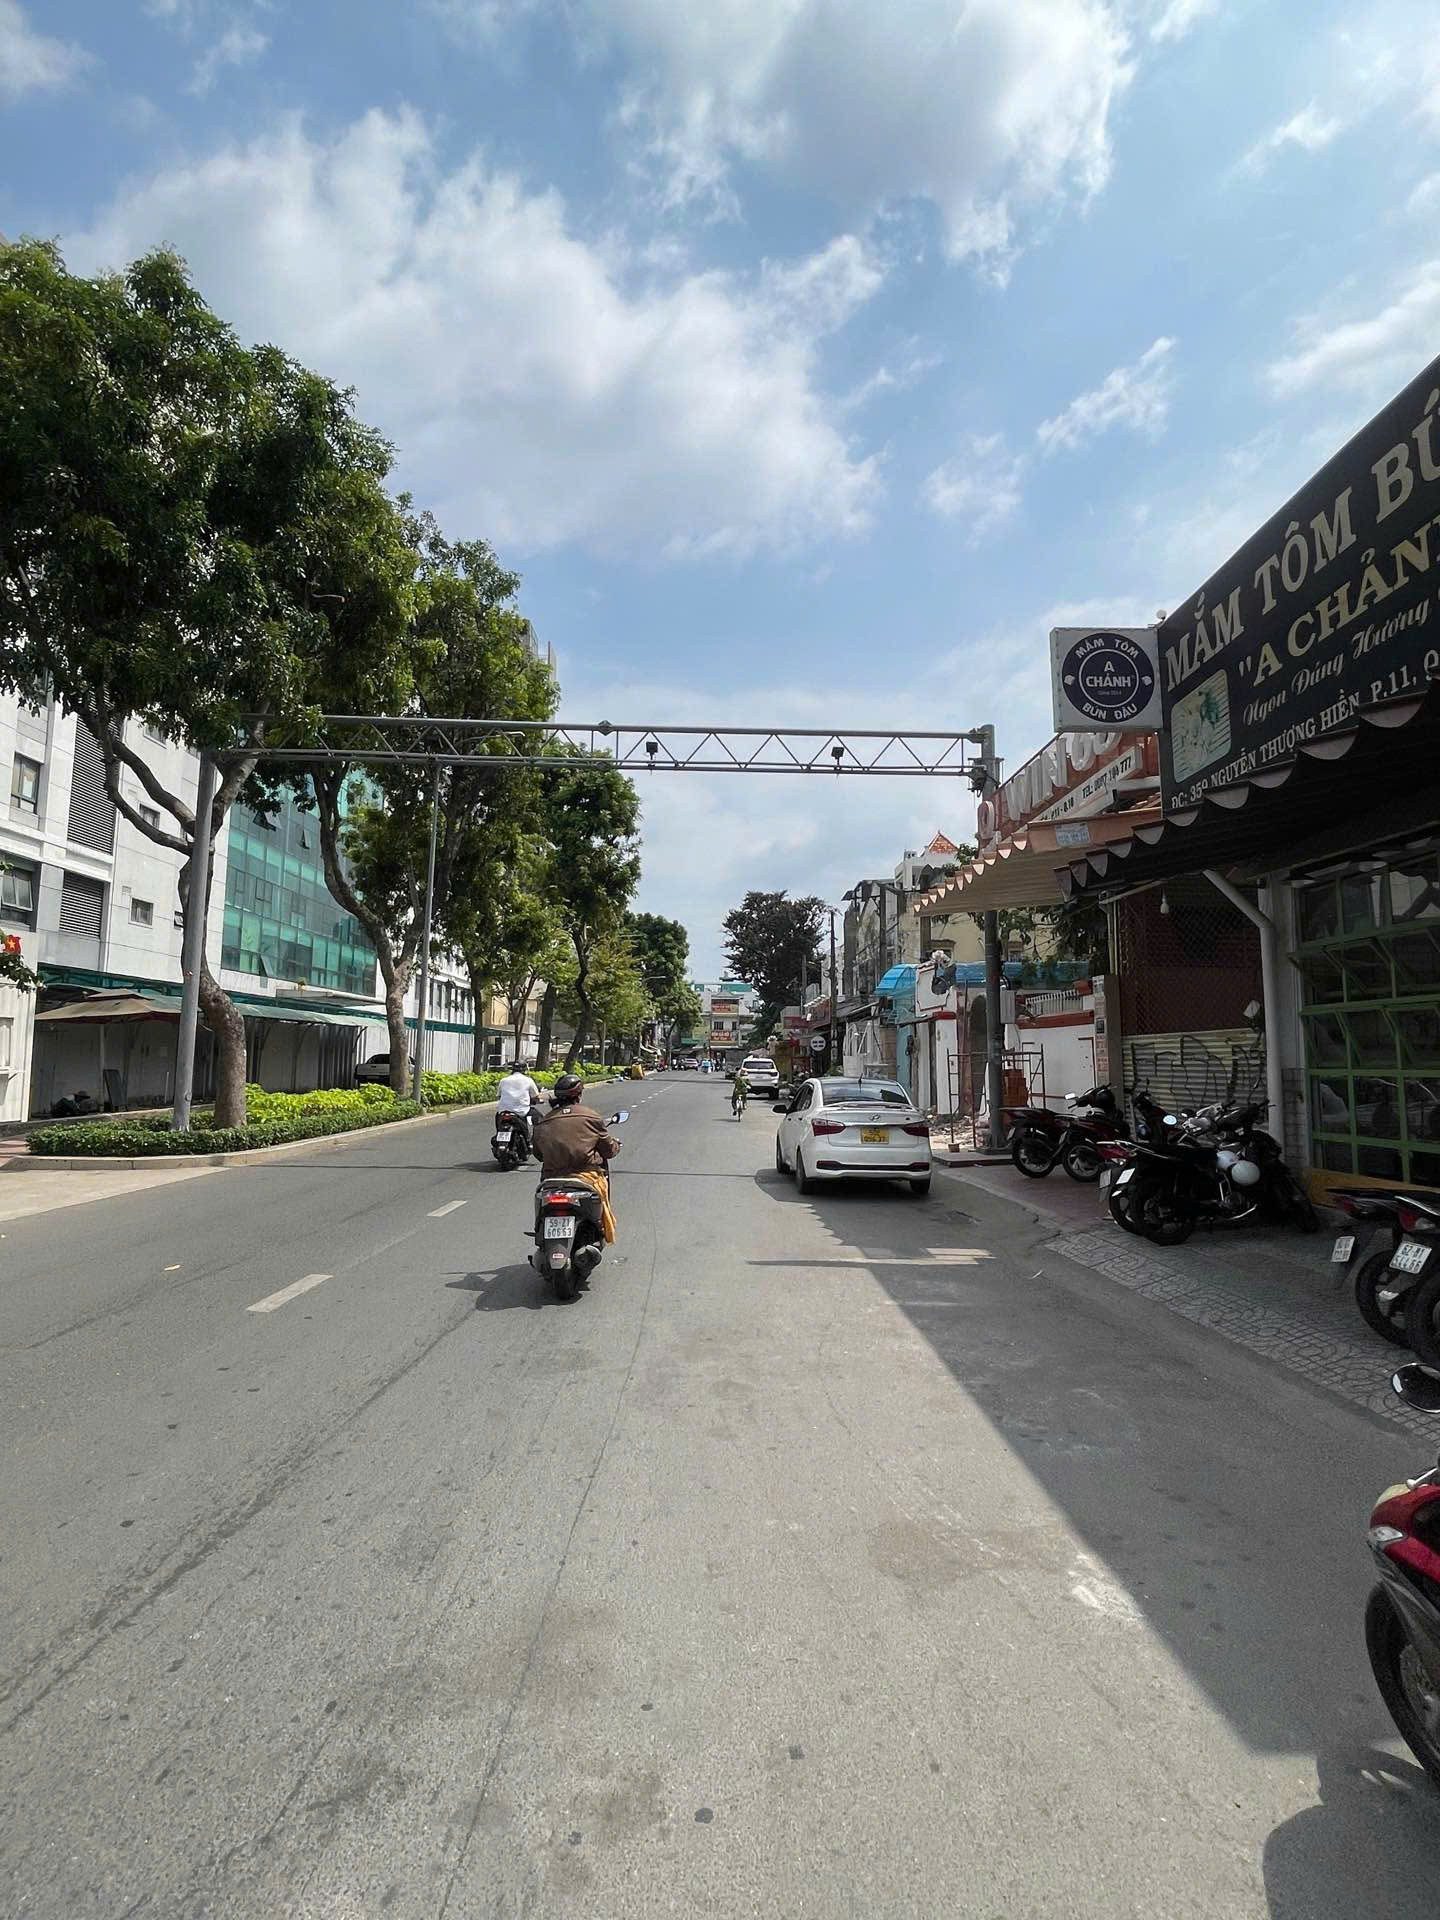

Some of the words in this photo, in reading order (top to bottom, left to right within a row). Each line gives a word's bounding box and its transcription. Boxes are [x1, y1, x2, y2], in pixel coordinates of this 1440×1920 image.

[1165, 586, 1245, 692] MẮM
[1254, 486, 1356, 616] TÔM
[1287, 514, 1440, 657] CHẢN
[1082, 702, 1107, 720] BÚN
[1104, 661, 1115, 672] A
[1243, 690, 1287, 726] Ngon
[1291, 653, 1344, 695] Đúng
[1352, 598, 1430, 660] Hương
[1260, 717, 1316, 762] THƯỢNG
[1320, 689, 1359, 732] HIỀN
